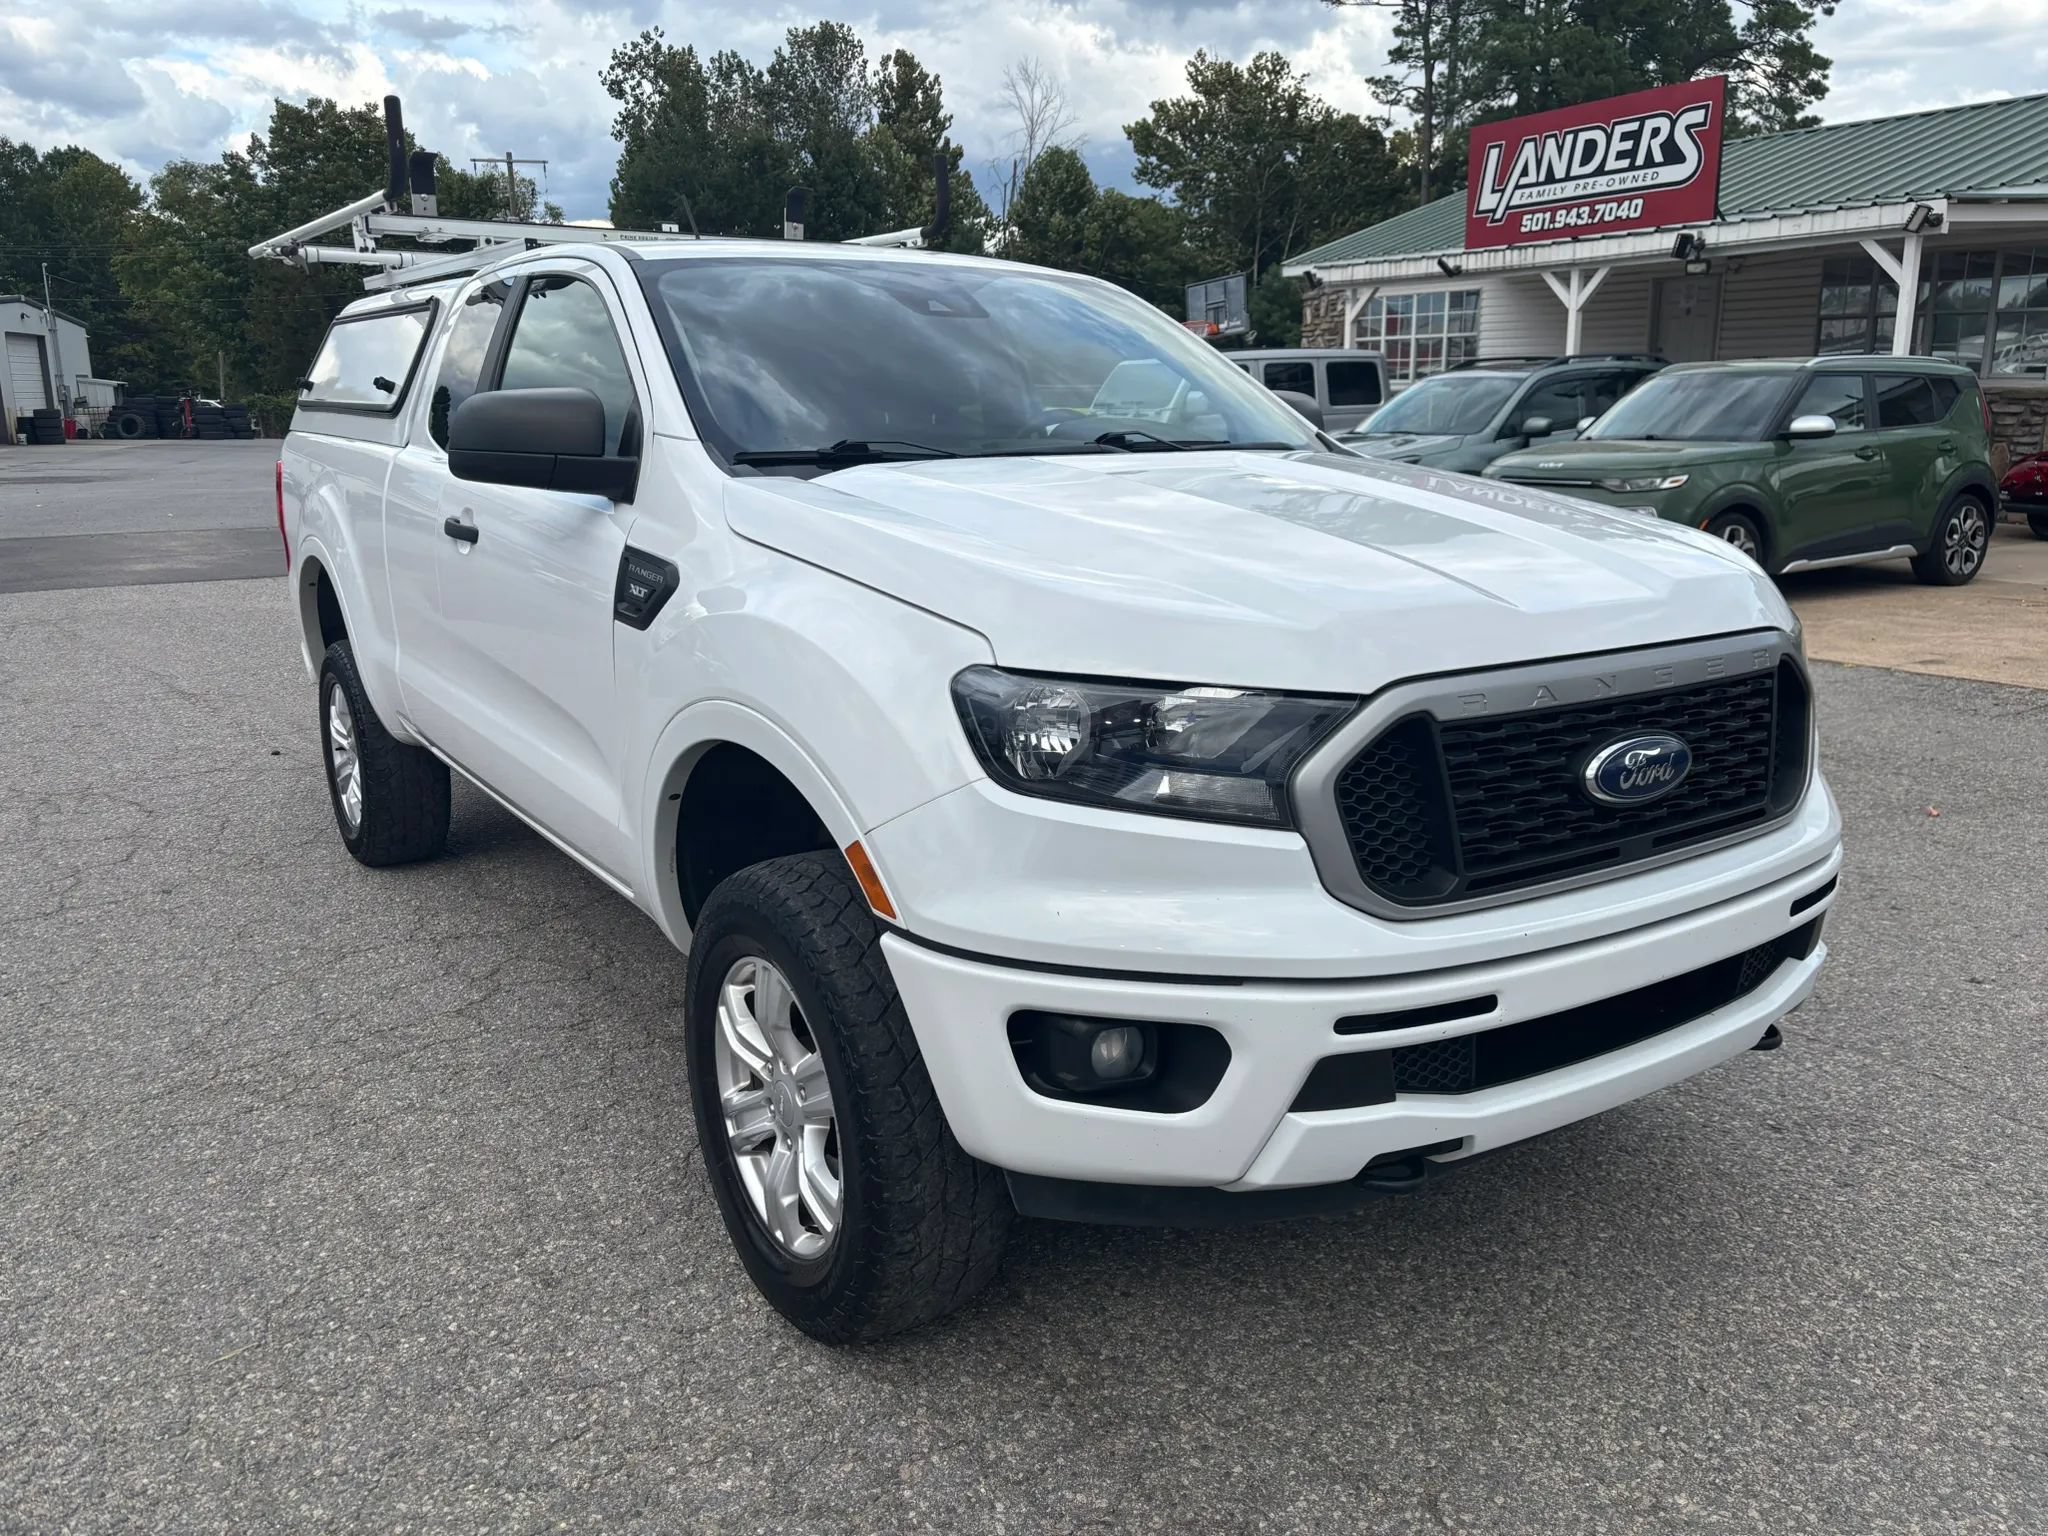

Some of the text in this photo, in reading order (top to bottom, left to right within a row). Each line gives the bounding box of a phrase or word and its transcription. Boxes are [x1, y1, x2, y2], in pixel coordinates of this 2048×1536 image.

[1476, 104, 1709, 222] LANDERS
[1519, 170, 1660, 202] FAMILY PRE-OWNED
[1520, 198, 1645, 233] 501.943.7040
[628, 563, 664, 584] RANGER
[629, 583, 648, 598] XLT
[1456, 648, 1771, 716] RANGER
[1619, 747, 1676, 791] Ford
